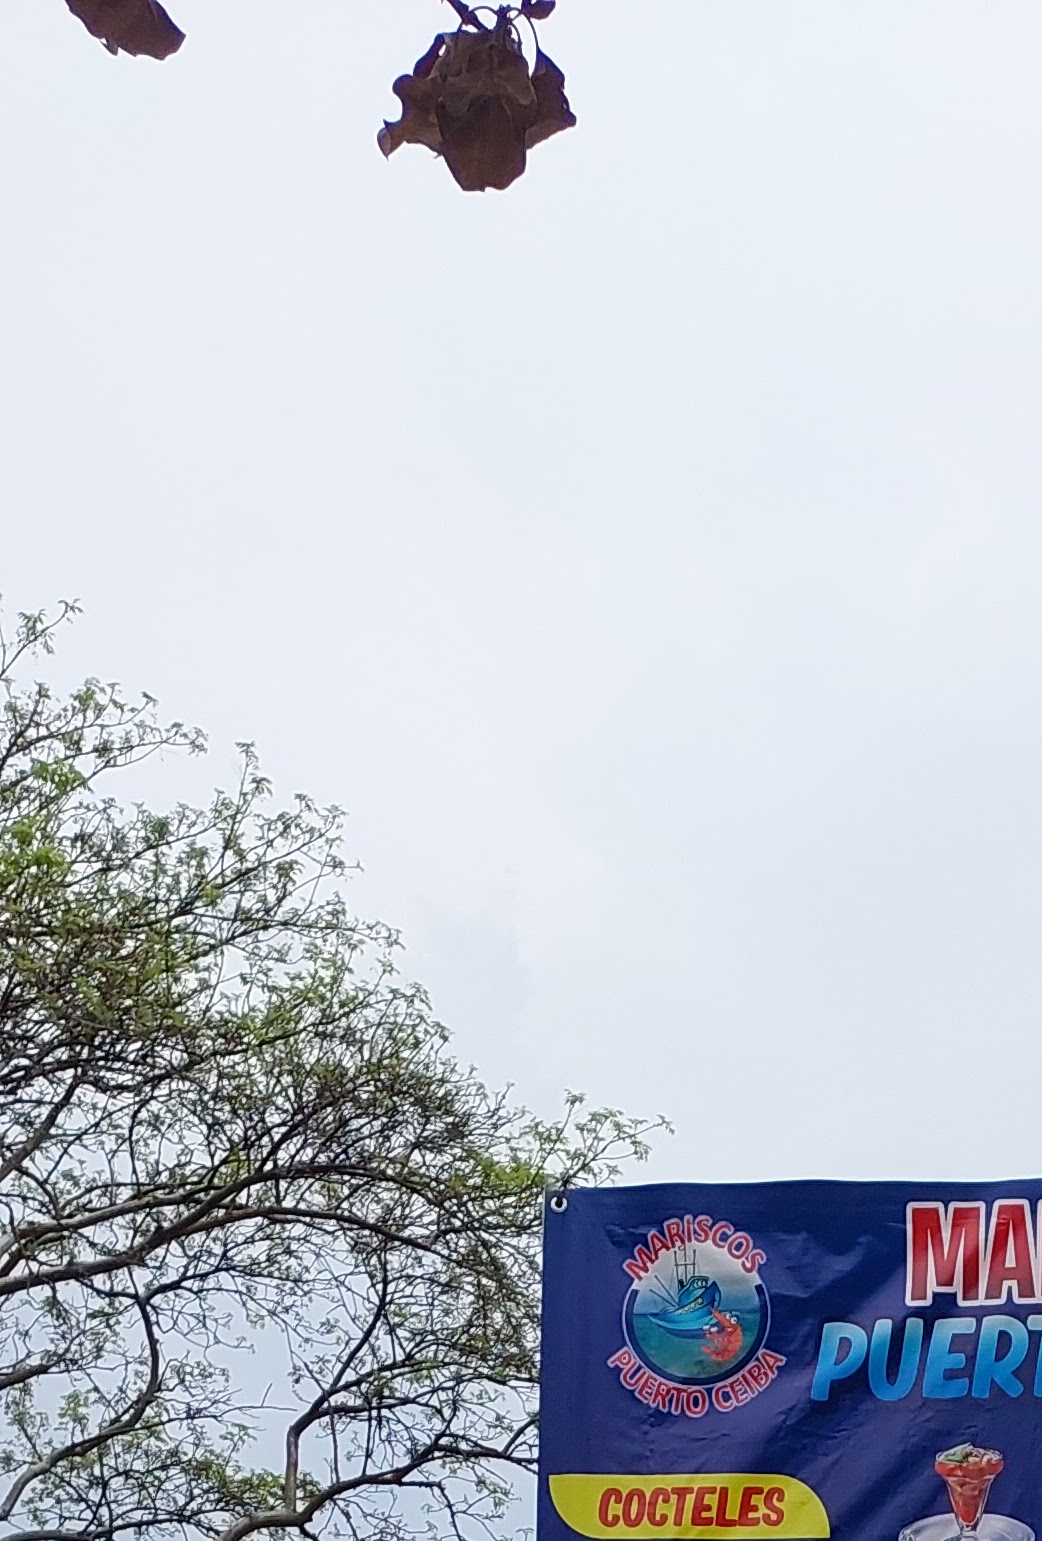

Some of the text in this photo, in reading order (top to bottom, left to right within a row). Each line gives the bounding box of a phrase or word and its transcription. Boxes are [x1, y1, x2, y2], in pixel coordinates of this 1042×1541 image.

[622, 1215, 767, 1282] MARISCOS
[607, 1346, 788, 1418] PUERTO CEIBA
[598, 1486, 785, 1529] COCTELES
